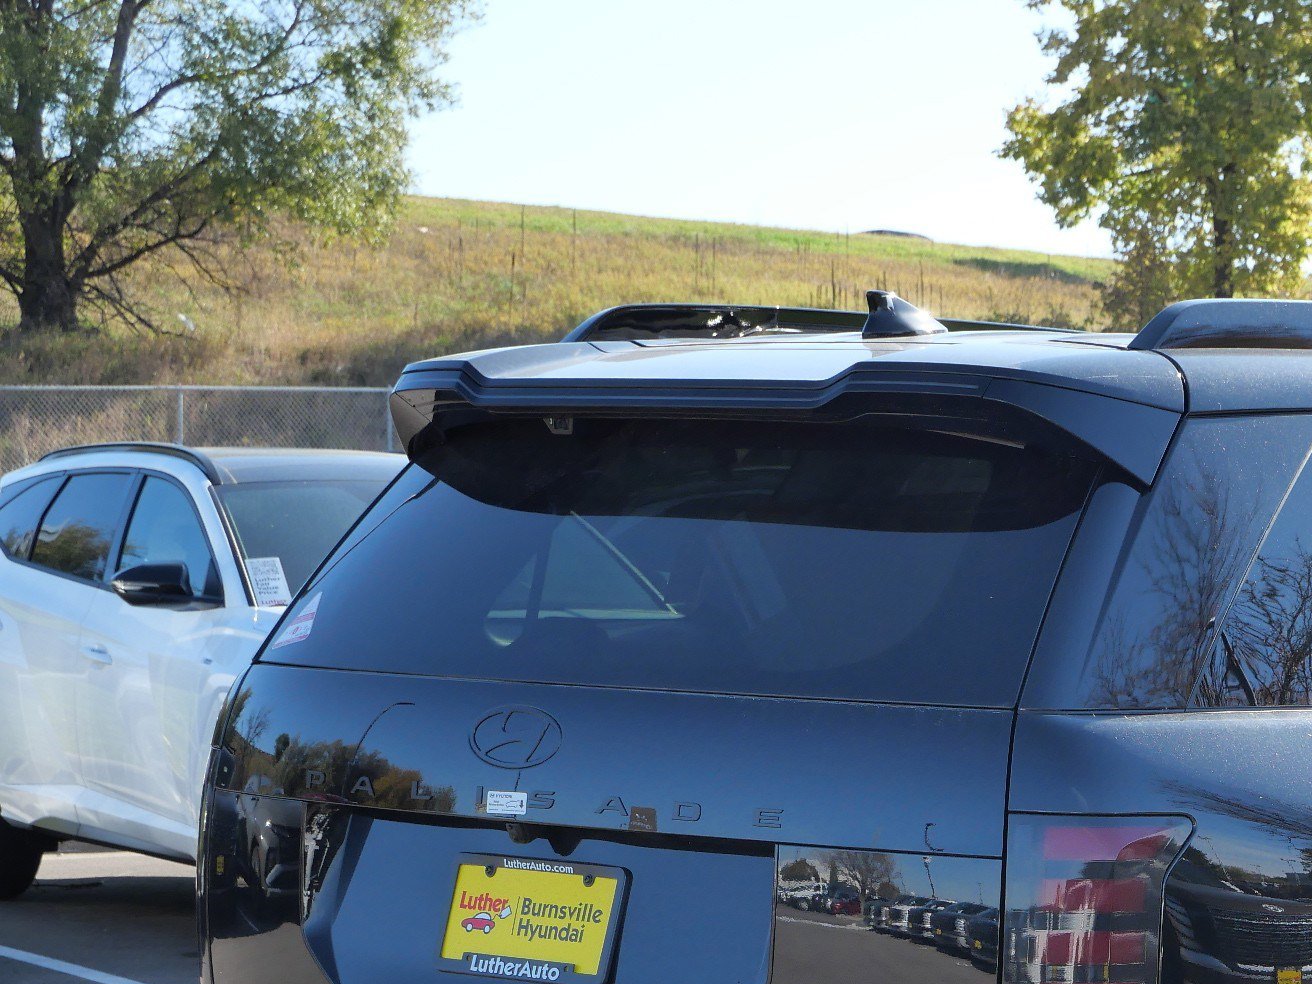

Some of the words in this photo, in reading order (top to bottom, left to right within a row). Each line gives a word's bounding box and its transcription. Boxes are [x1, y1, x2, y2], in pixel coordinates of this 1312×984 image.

[304, 769, 785, 829] PALISADE
[503, 858, 574, 875] LutherAuto.com
[459, 890, 509, 913] Luther
[520, 897, 604, 924] Burnsville
[516, 917, 586, 943] Hyundai
[469, 954, 560, 982] LutherAuto
